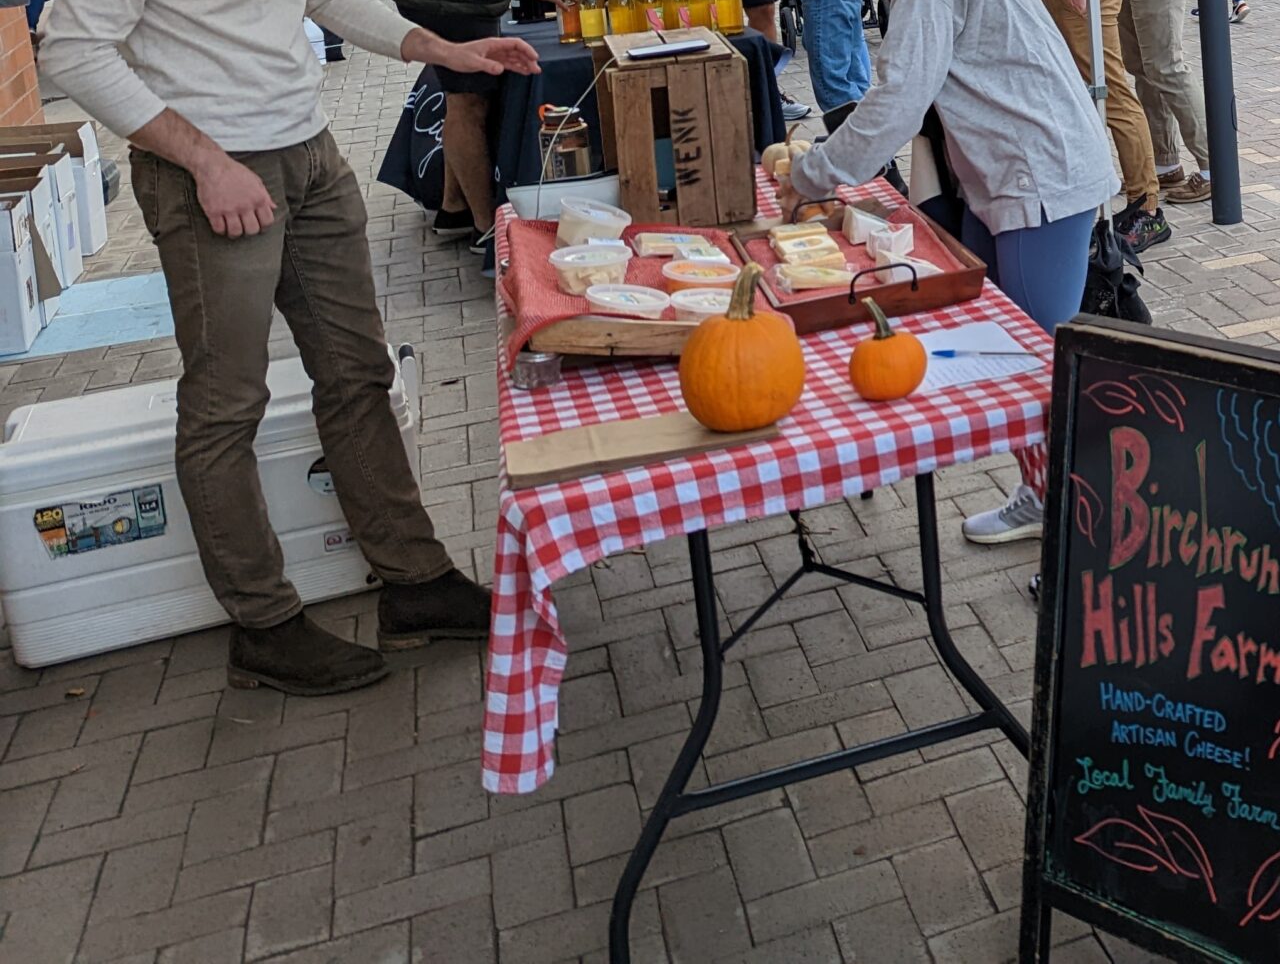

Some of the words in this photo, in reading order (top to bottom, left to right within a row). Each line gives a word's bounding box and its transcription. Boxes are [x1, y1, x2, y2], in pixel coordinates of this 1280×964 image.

[671, 107, 702, 188] WENK
[35, 507, 63, 523] 120
[1109, 426, 1280, 595] Birchrun
[1081, 570, 1176, 669] Hills
[1100, 682, 1227, 733] HAND-CRAFTED
[1111, 720, 1177, 747] ARTISAN
[1184, 731, 1251, 771] CHEESE!
[1076, 756, 1134, 794] Local
[1144, 762, 1216, 818] Family
[1221, 781, 1280, 830] Farm
